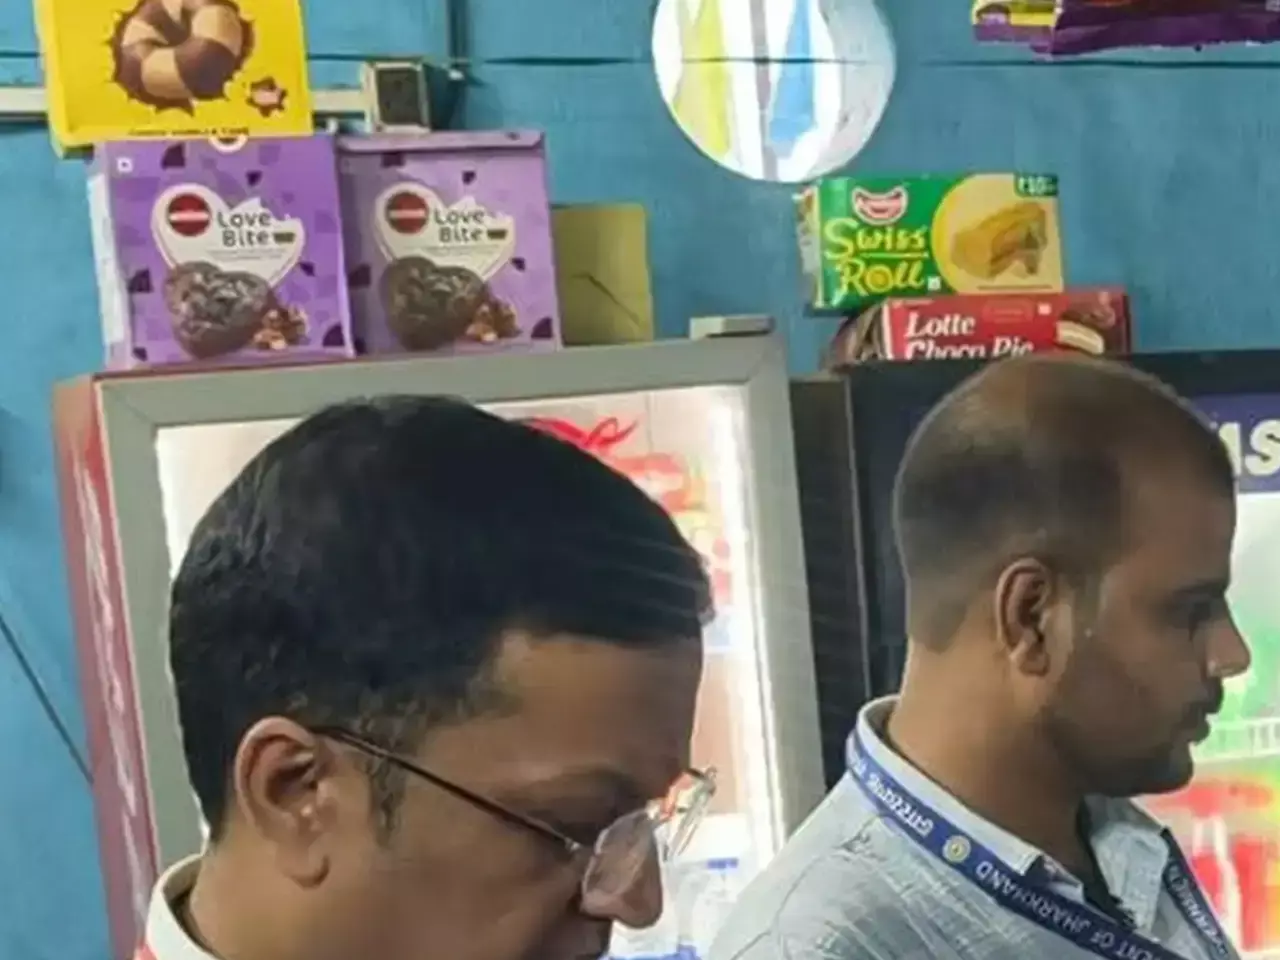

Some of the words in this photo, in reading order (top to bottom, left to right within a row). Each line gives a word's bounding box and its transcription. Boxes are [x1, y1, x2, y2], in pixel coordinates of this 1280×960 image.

[216, 210, 271, 229] Love
[433, 208, 485, 224] Love
[222, 230, 270, 248] Bite
[438, 227, 483, 243] Bite
[823, 217, 927, 260] Swiss
[834, 258, 926, 306] Roll
[904, 312, 977, 338] Lotte
[975, 859, 1092, 933] JHARKHAND
